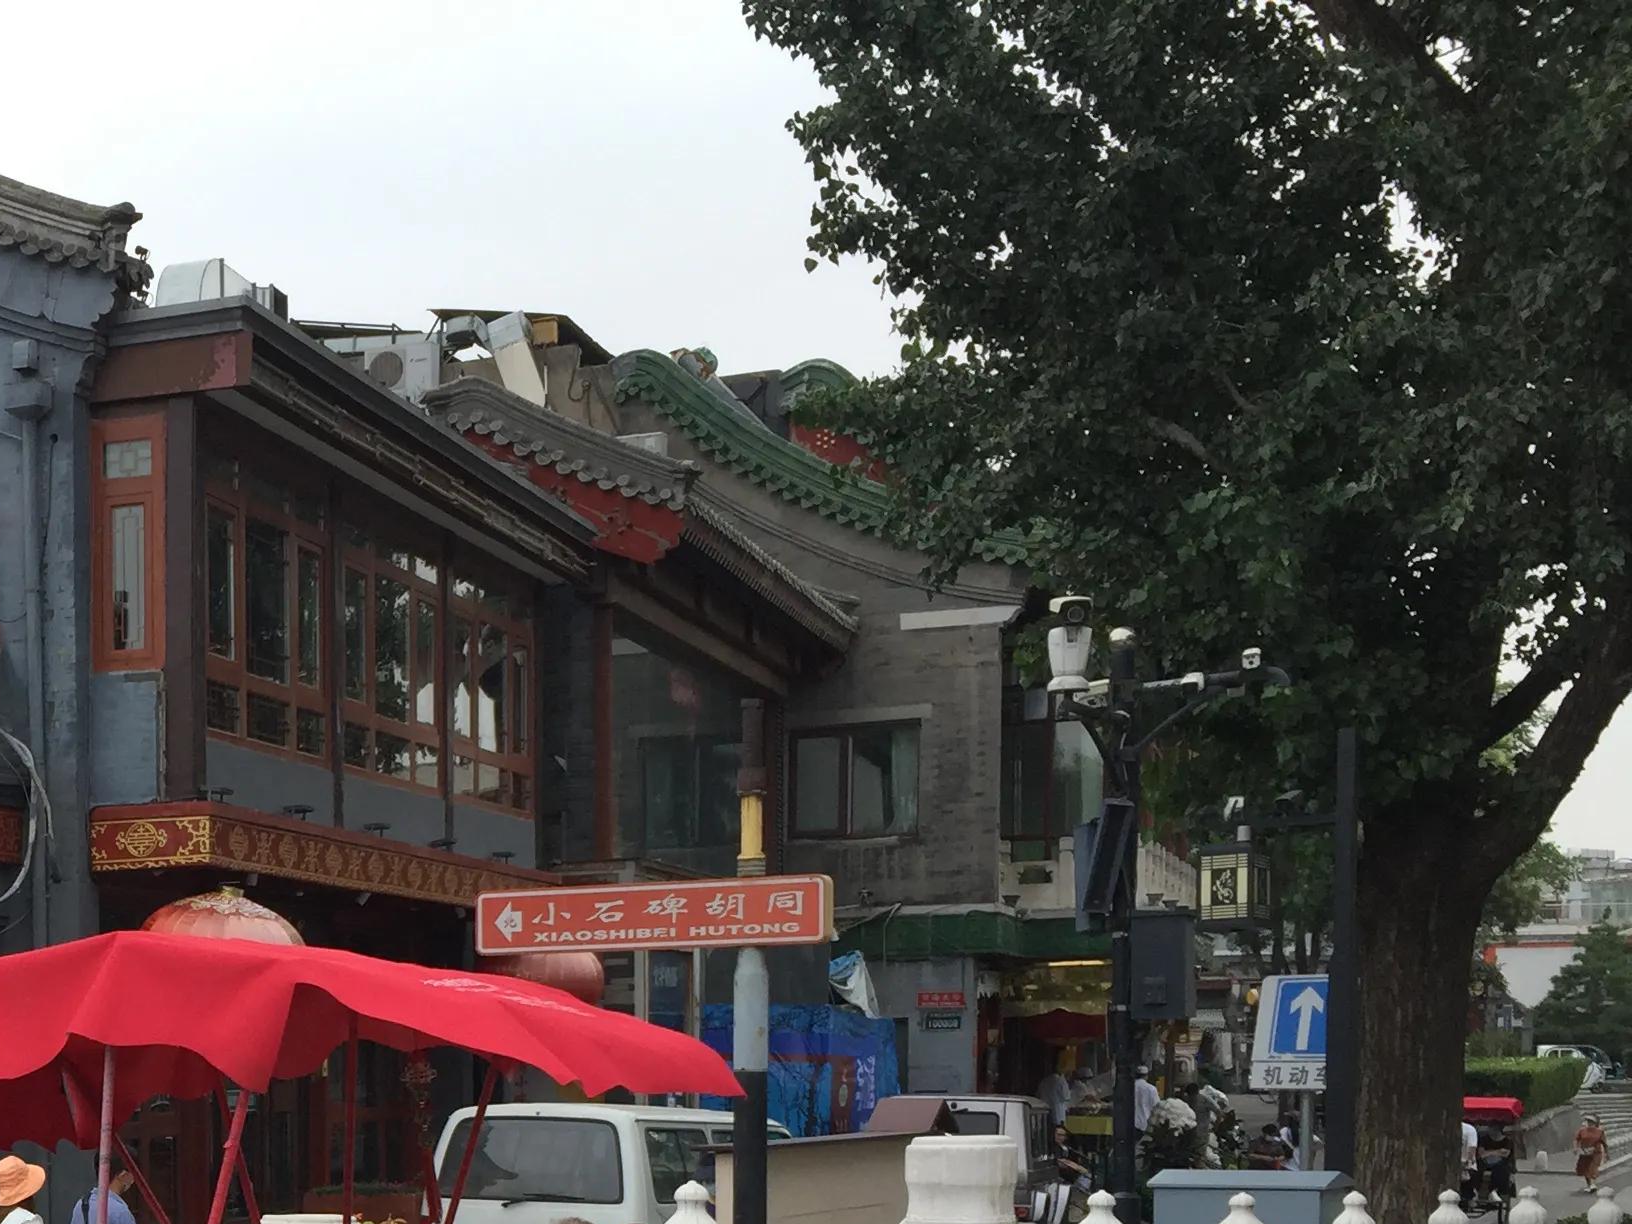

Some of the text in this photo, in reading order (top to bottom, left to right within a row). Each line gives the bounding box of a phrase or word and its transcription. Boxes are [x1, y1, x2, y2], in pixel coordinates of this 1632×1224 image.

[532, 891, 804, 926] 小石碑胡同
[689, 922, 800, 937] HUTONG
